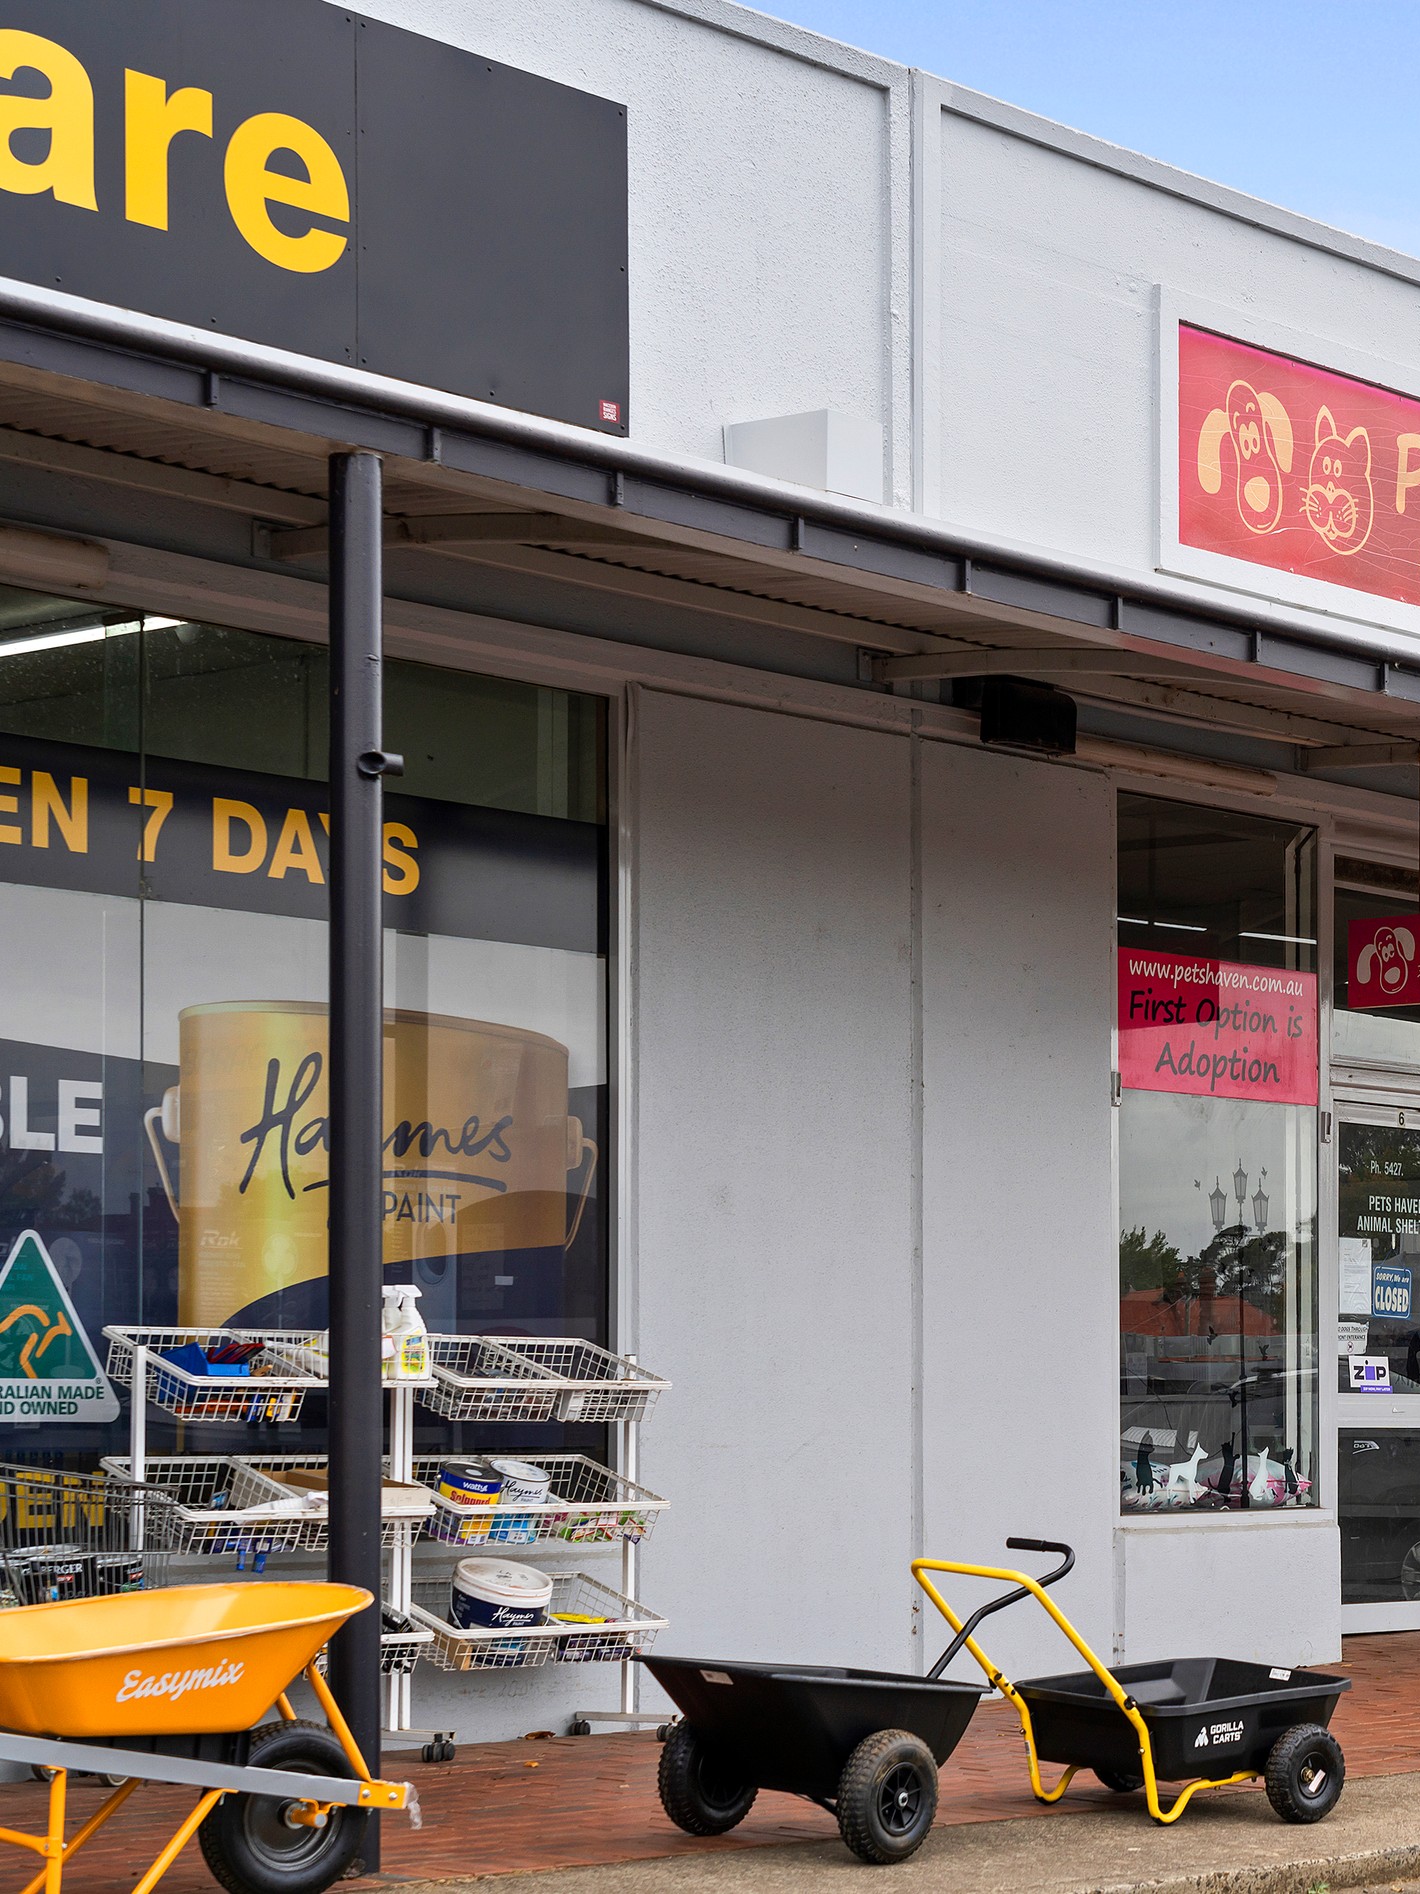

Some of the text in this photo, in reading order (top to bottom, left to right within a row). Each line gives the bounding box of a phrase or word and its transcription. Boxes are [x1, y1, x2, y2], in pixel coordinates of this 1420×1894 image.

[0, 28, 350, 273] are
[128, 786, 174, 863] 7
[212, 797, 421, 896] DAS
[1129, 959, 1304, 997] www.petshaven.com.au
[1129, 988, 1303, 1041] First Option is
[1155, 1040, 1280, 1092] Adoption
[0, 1074, 104, 1154] LE
[239, 1051, 513, 1200] Hames
[1398, 1111, 1405, 1126] 6
[1370, 1160, 1382, 1174] Ph.
[382, 1190, 462, 1225] PAINT
[1369, 1195, 1392, 1213] PETS
[1357, 1215, 1393, 1233] ANIMAL
[1375, 1285, 1409, 1313] CLOSED
[57, 1385, 105, 1400] MADE
[20, 1401, 78, 1415] OWNED
[492, 1606, 535, 1627] Haymes
[115, 1658, 246, 1703] Easymix
[1210, 1720, 1245, 1735] GORILLA
[1213, 1732, 1242, 1745] CARTS
